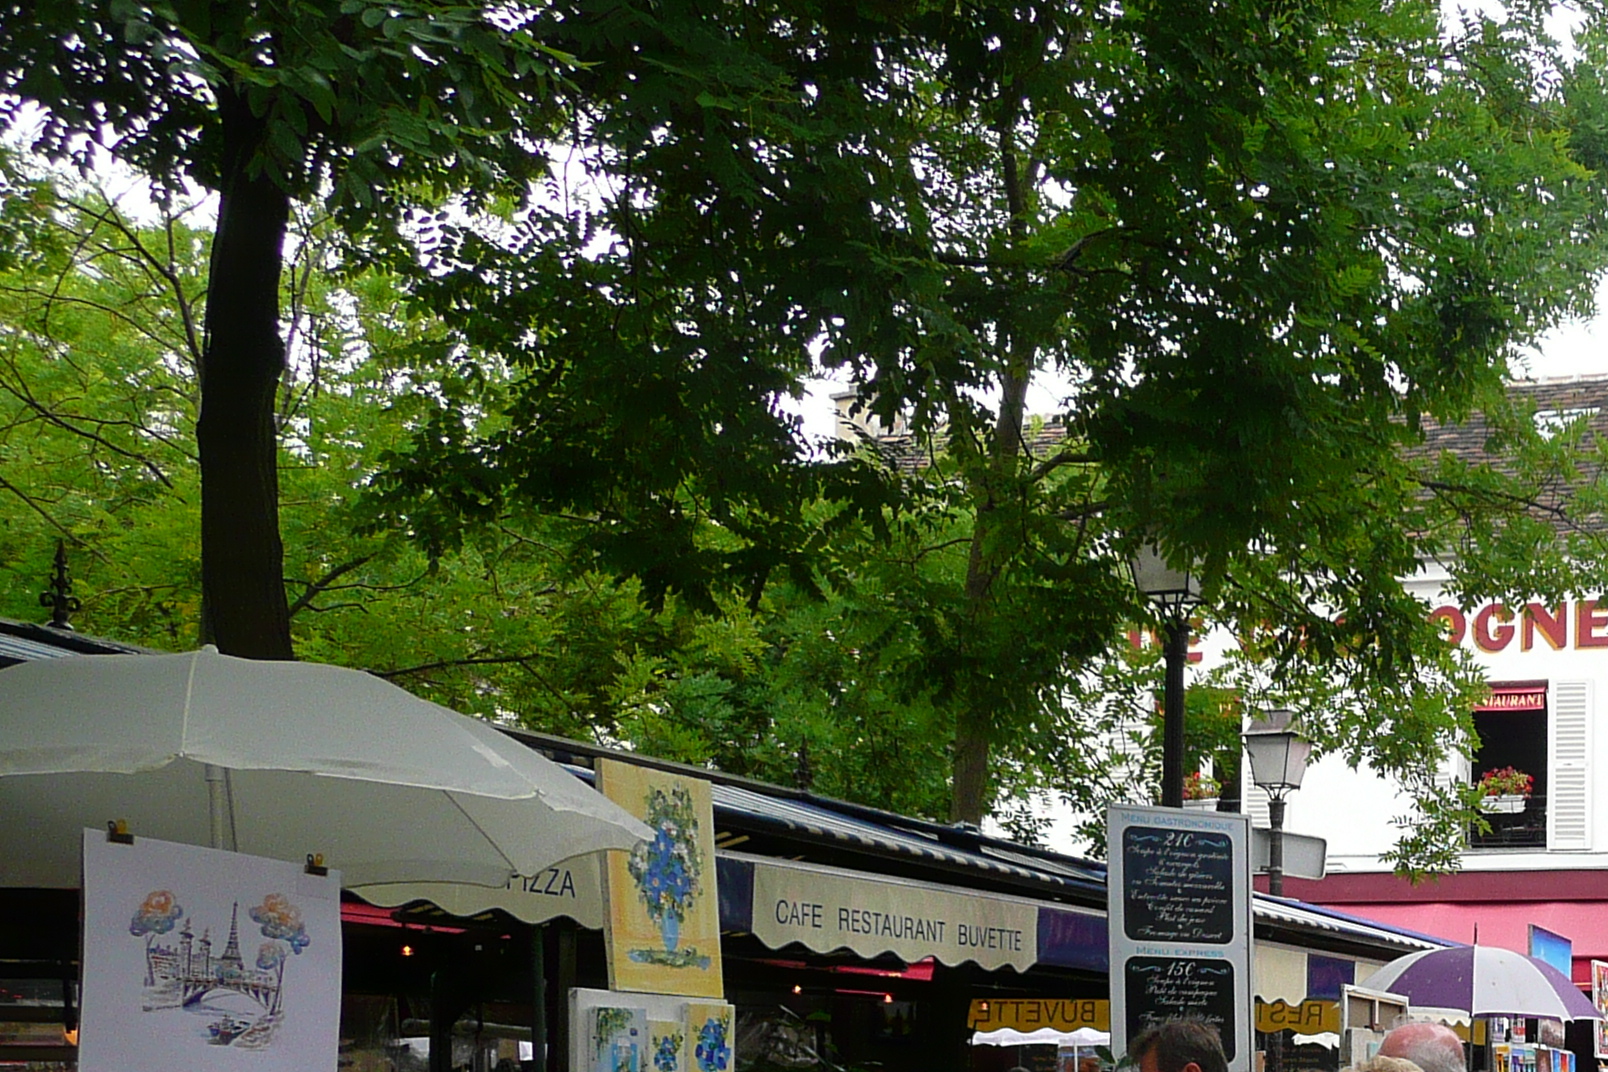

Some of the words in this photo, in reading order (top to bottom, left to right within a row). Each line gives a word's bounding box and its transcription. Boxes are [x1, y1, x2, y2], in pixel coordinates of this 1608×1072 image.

[1482, 693, 1544, 708] STAURANT
[507, 868, 576, 899] IZZA
[775, 899, 824, 928] CAFE
[838, 907, 946, 943] RESTAURANT
[958, 924, 1023, 951] BUVETTE
[1136, 946, 1170, 955] MENU
[1174, 948, 1225, 958] EXPRESS
